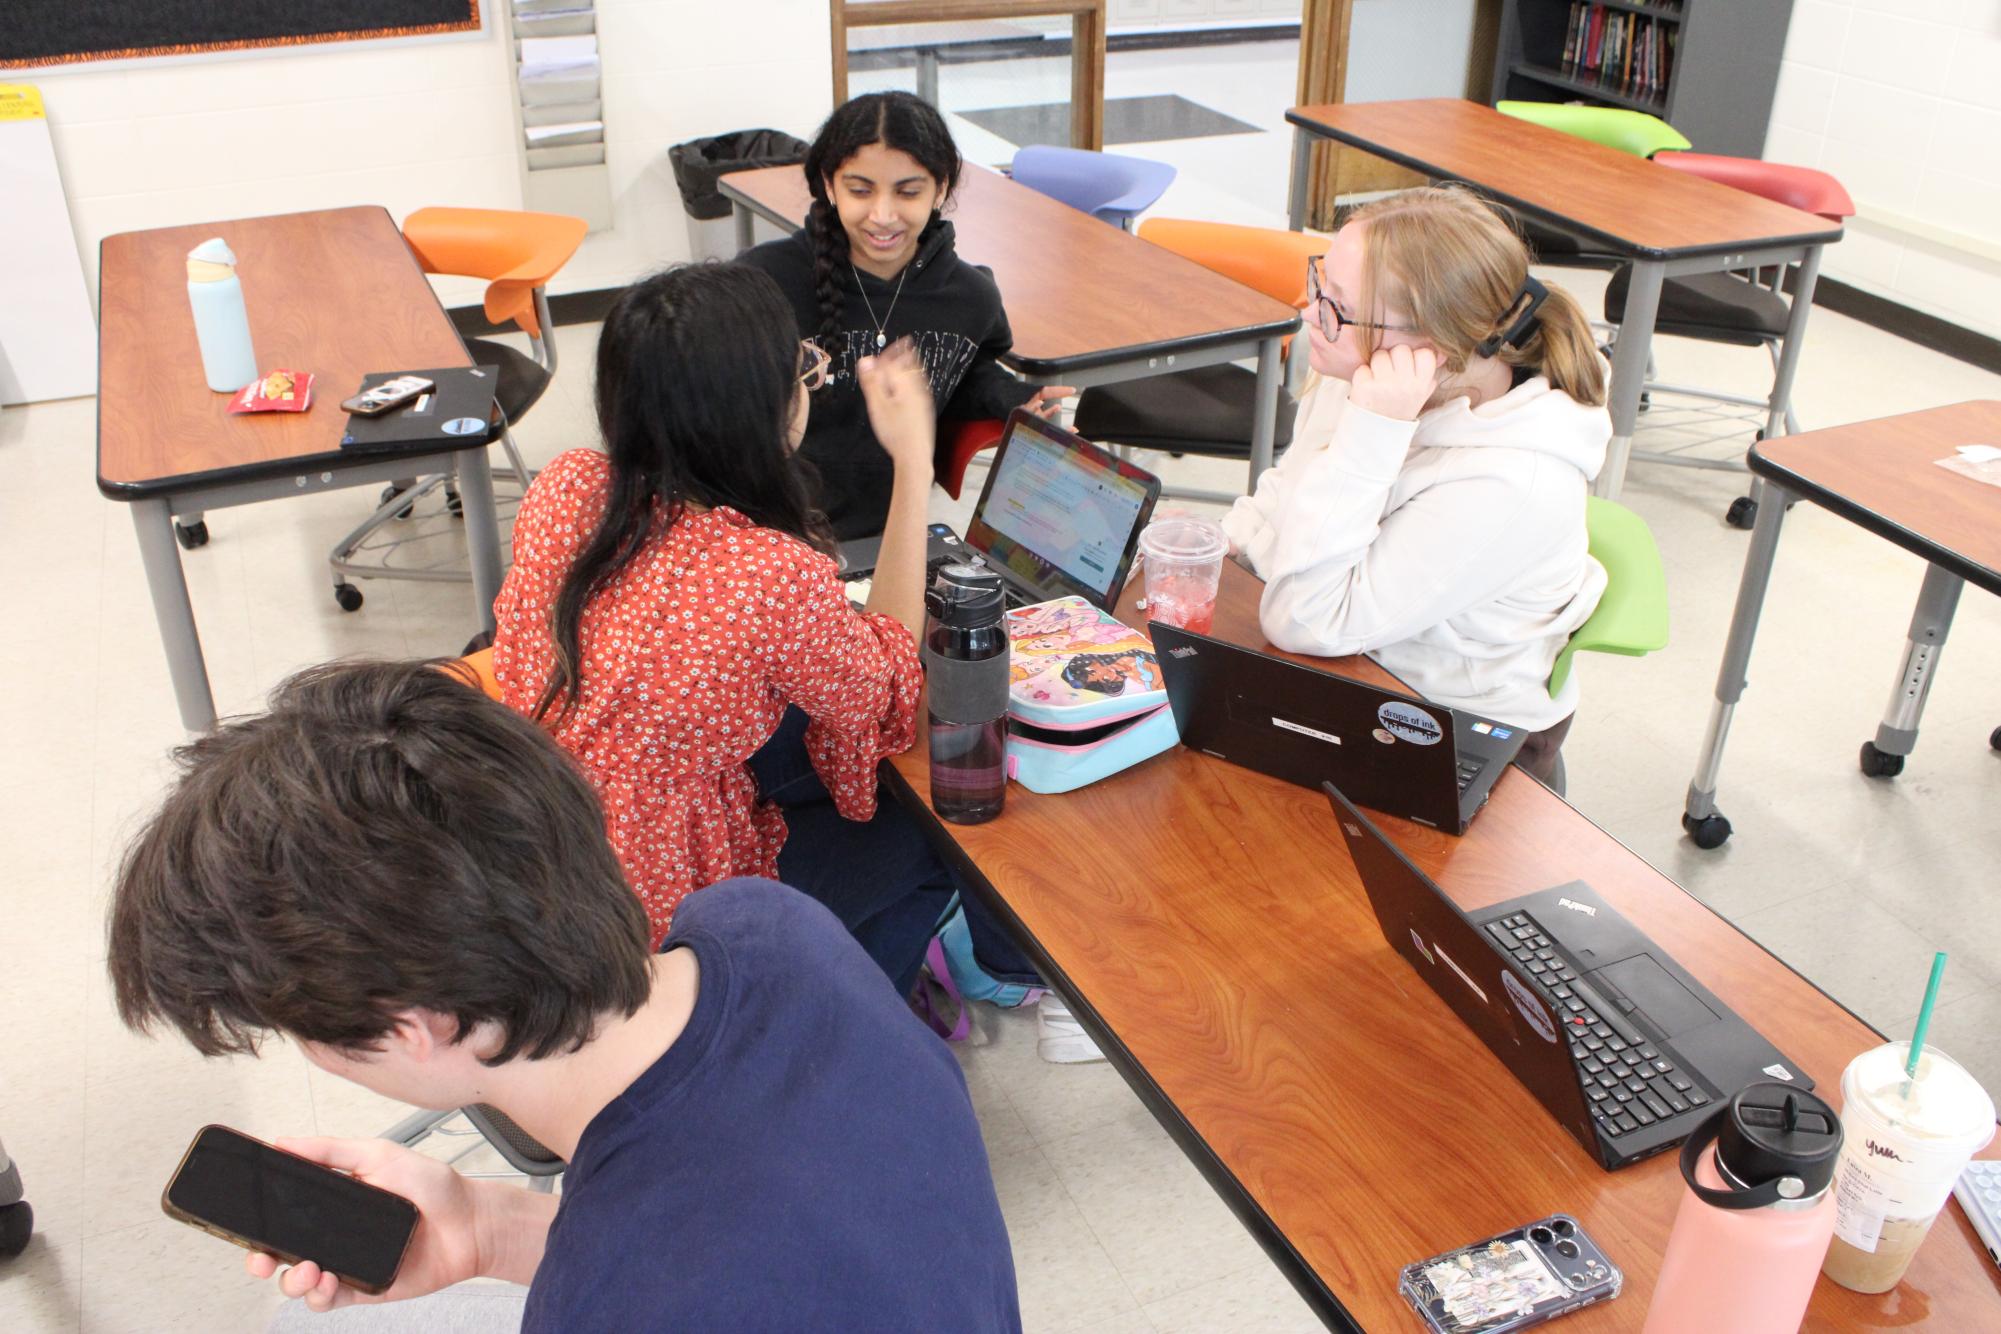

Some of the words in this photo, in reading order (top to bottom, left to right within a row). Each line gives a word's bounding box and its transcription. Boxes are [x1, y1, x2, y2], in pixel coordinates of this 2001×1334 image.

[1384, 709, 1408, 722] drops
[1411, 717, 1420, 726] of
[1422, 720, 1436, 730] ink
